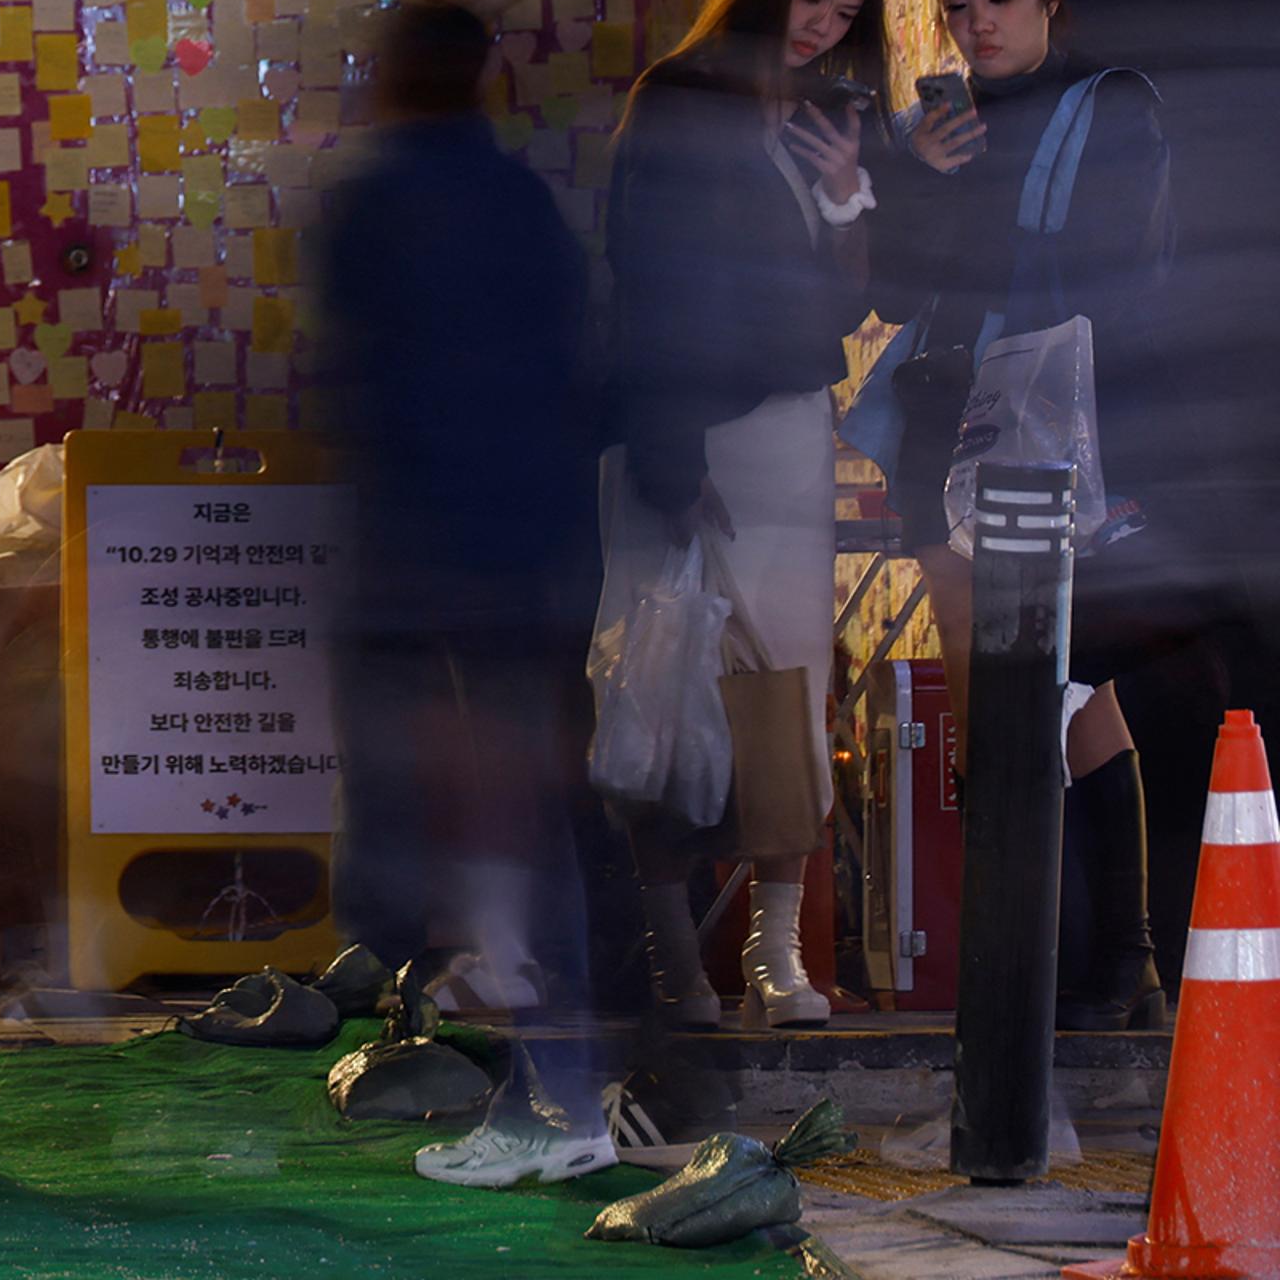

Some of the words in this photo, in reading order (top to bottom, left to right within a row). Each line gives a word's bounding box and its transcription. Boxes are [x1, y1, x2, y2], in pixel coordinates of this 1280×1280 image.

[193, 502, 251, 522] 지금은
[183, 544, 240, 565] 기억과
[246, 544, 303, 565] 안전의
[141, 587, 179, 606] 조성
[185, 586, 306, 607] 공사중입니다.
[142, 629, 199, 650] 통행에
[205, 629, 262, 650] 불편을
[268, 628, 306, 649] 드려
[173, 670, 277, 691] 죄송합니다.
[150, 713, 187, 733] 보다
[194, 713, 251, 733] 안전한
[257, 713, 296, 733] 길을
[101, 754, 158, 775] 만들기
[165, 754, 203, 775] 위해
